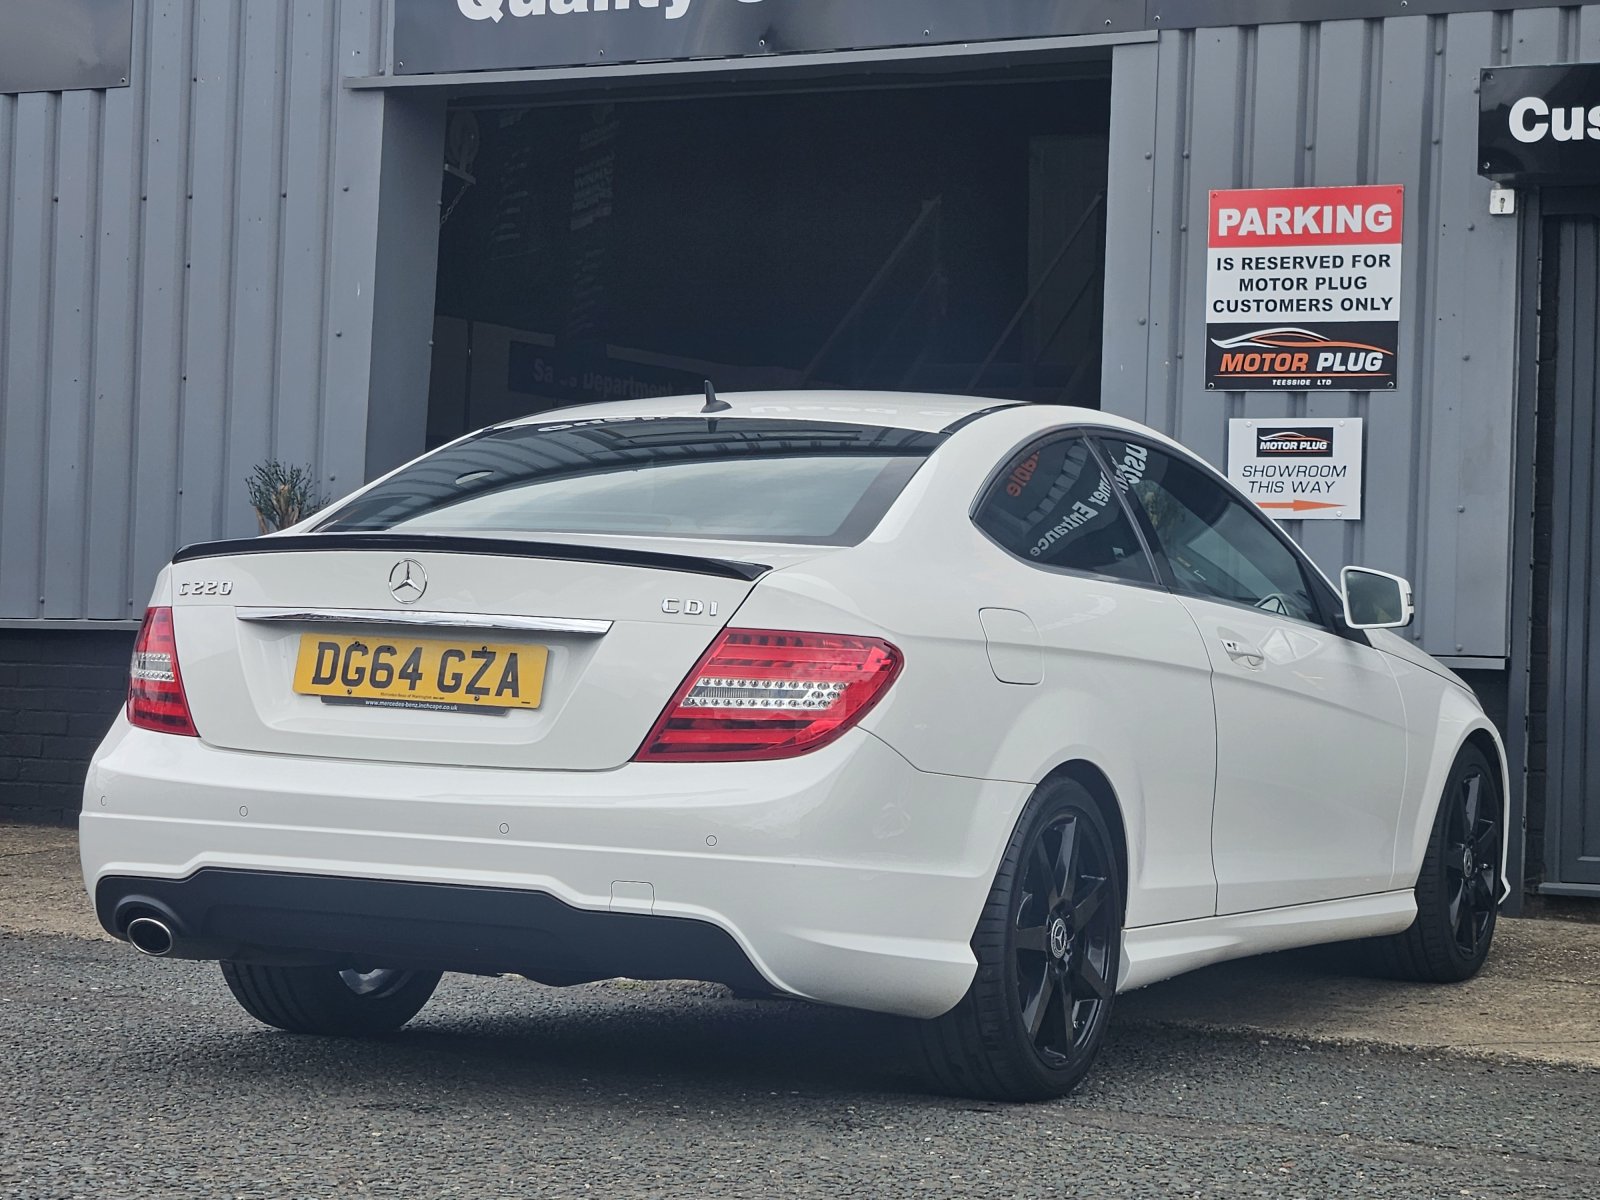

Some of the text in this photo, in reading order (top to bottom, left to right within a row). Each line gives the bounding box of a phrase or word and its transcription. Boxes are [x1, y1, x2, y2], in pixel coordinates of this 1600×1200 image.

[1218, 204, 1392, 236] PARKING
[1216, 254, 1391, 271] IS RESERVED FOR
[1239, 276, 1367, 291] MOTOR PLUG
[1213, 297, 1393, 313] CUSTOMERS ONLY
[1219, 352, 1383, 372] MOTOR PLUG
[1260, 441, 1327, 450] MOTOR PLUG
[1242, 465, 1347, 478] SHOWROOM
[1249, 481, 1336, 493] THIS WAY
[662, 598, 718, 616] CDI
[312, 641, 520, 698] DG64 GZA
